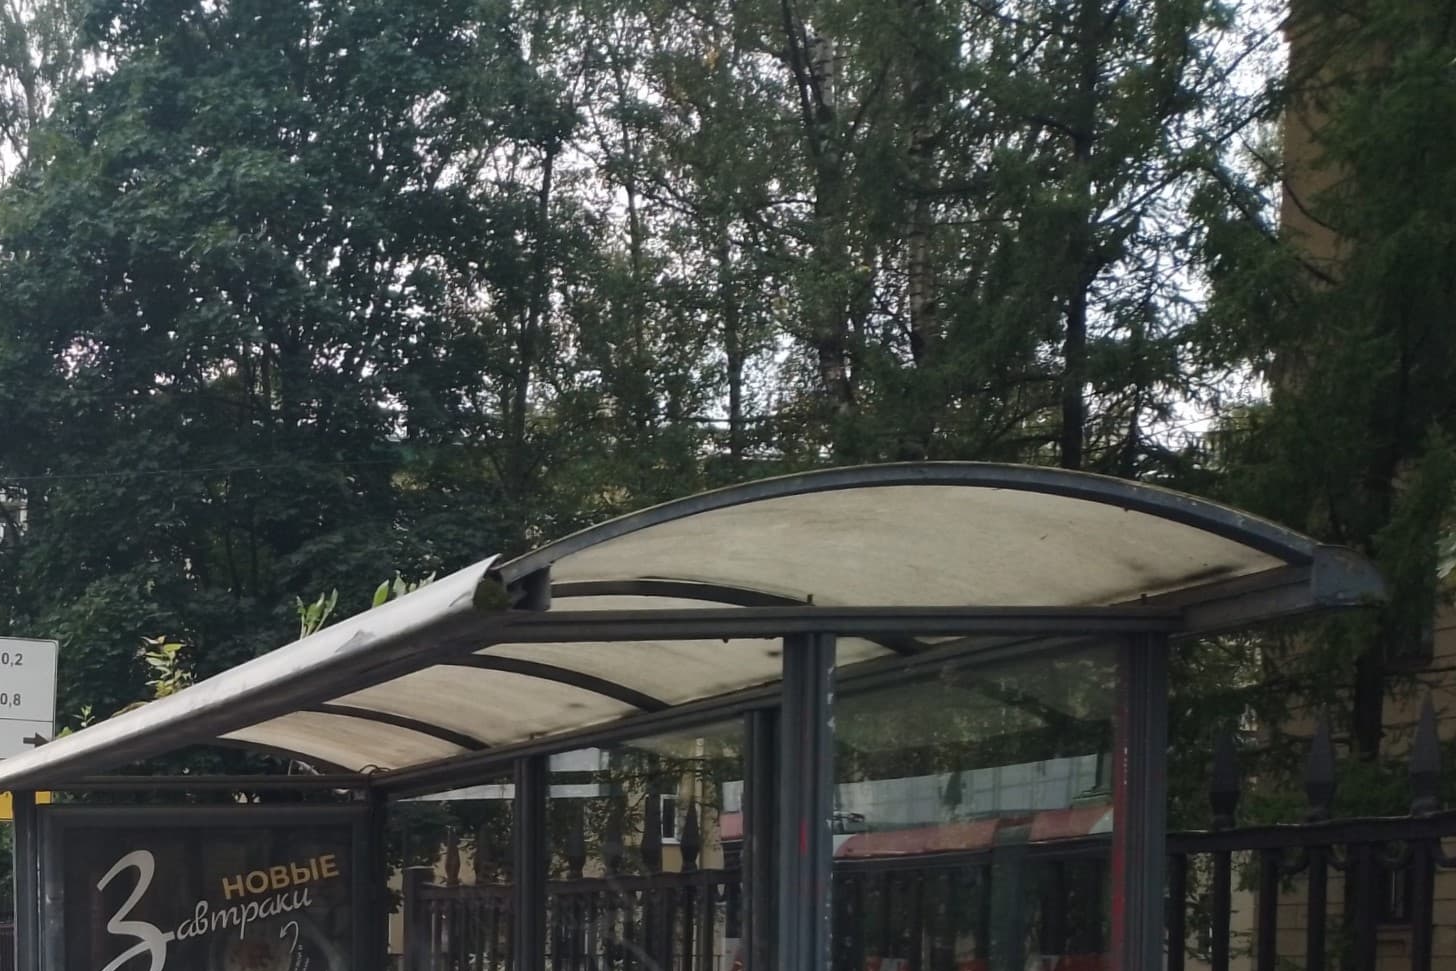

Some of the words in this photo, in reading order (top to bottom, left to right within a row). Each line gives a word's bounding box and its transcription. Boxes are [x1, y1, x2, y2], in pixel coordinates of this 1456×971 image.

[1, 652, 23, 666] 0,2
[0, 692, 21, 706] 0,8
[222, 854, 339, 899] НОВЫЕ
